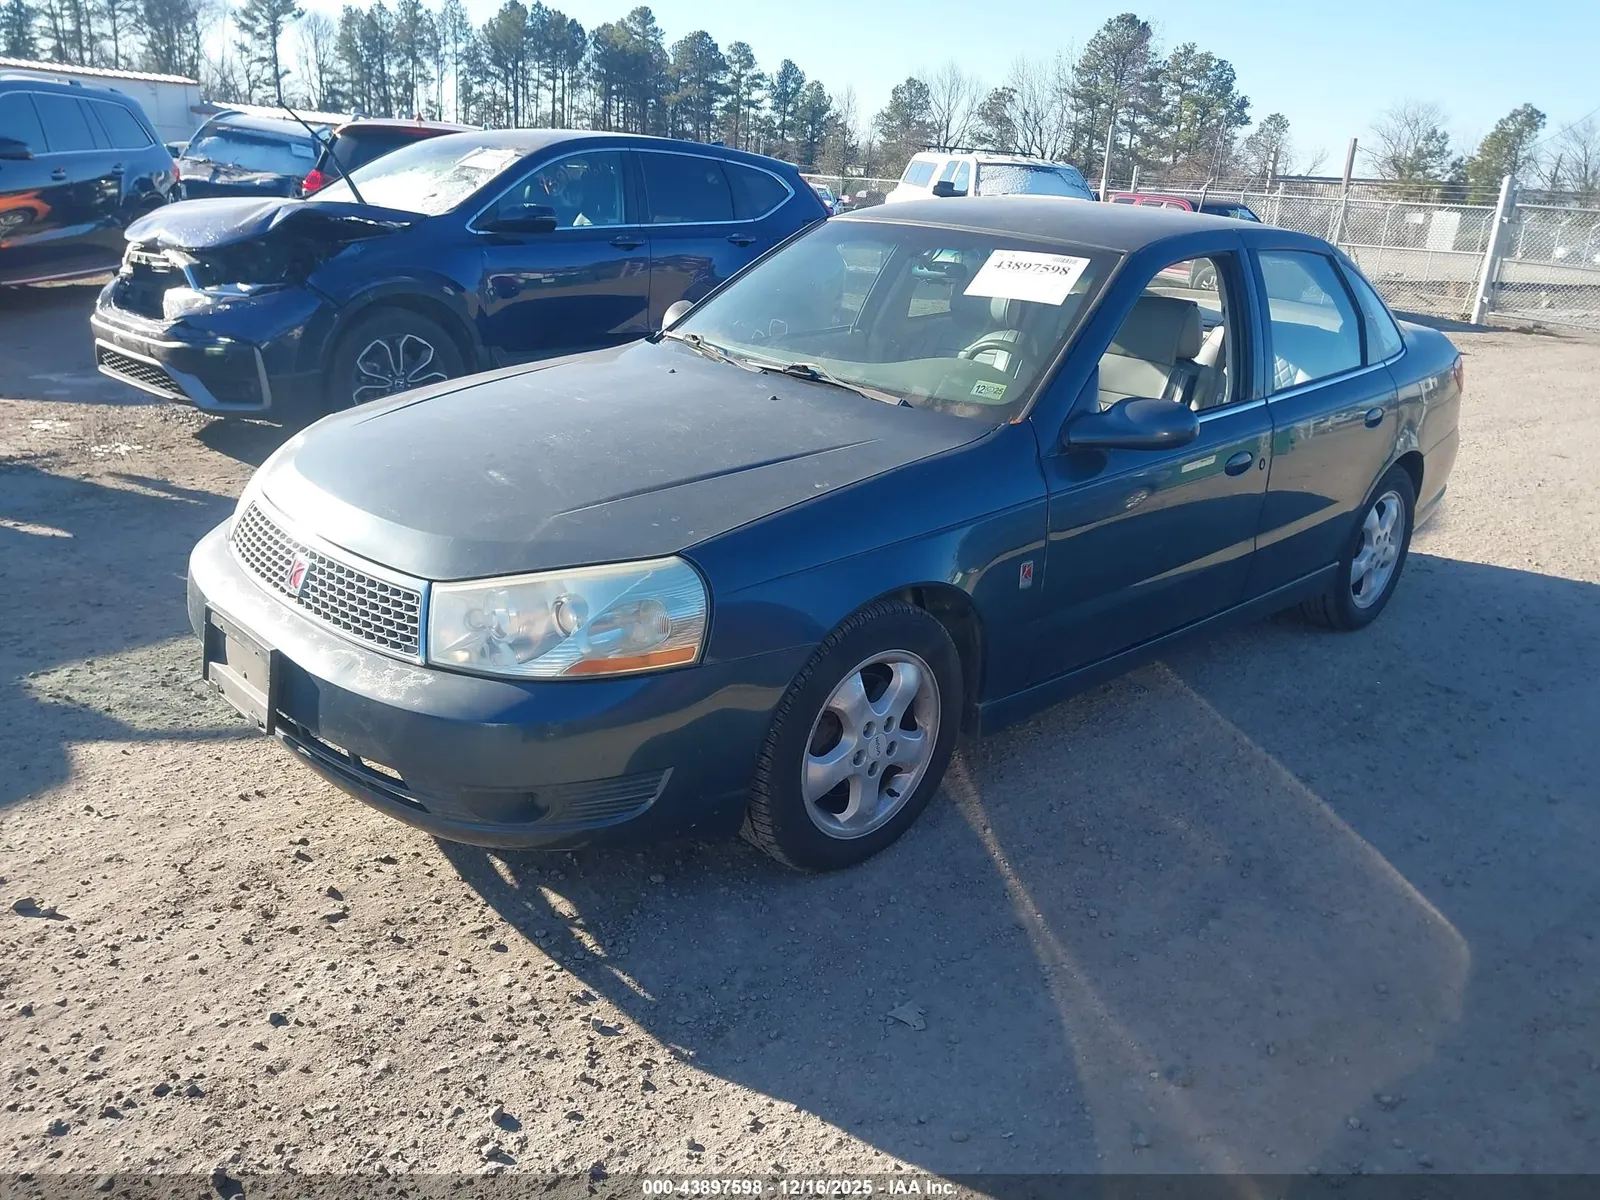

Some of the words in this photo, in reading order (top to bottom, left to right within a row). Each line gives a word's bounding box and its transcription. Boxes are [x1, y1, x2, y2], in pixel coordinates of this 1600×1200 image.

[994, 260, 1071, 276] 43897598
[975, 384, 986, 394] 12
[993, 386, 1004, 395] 25
